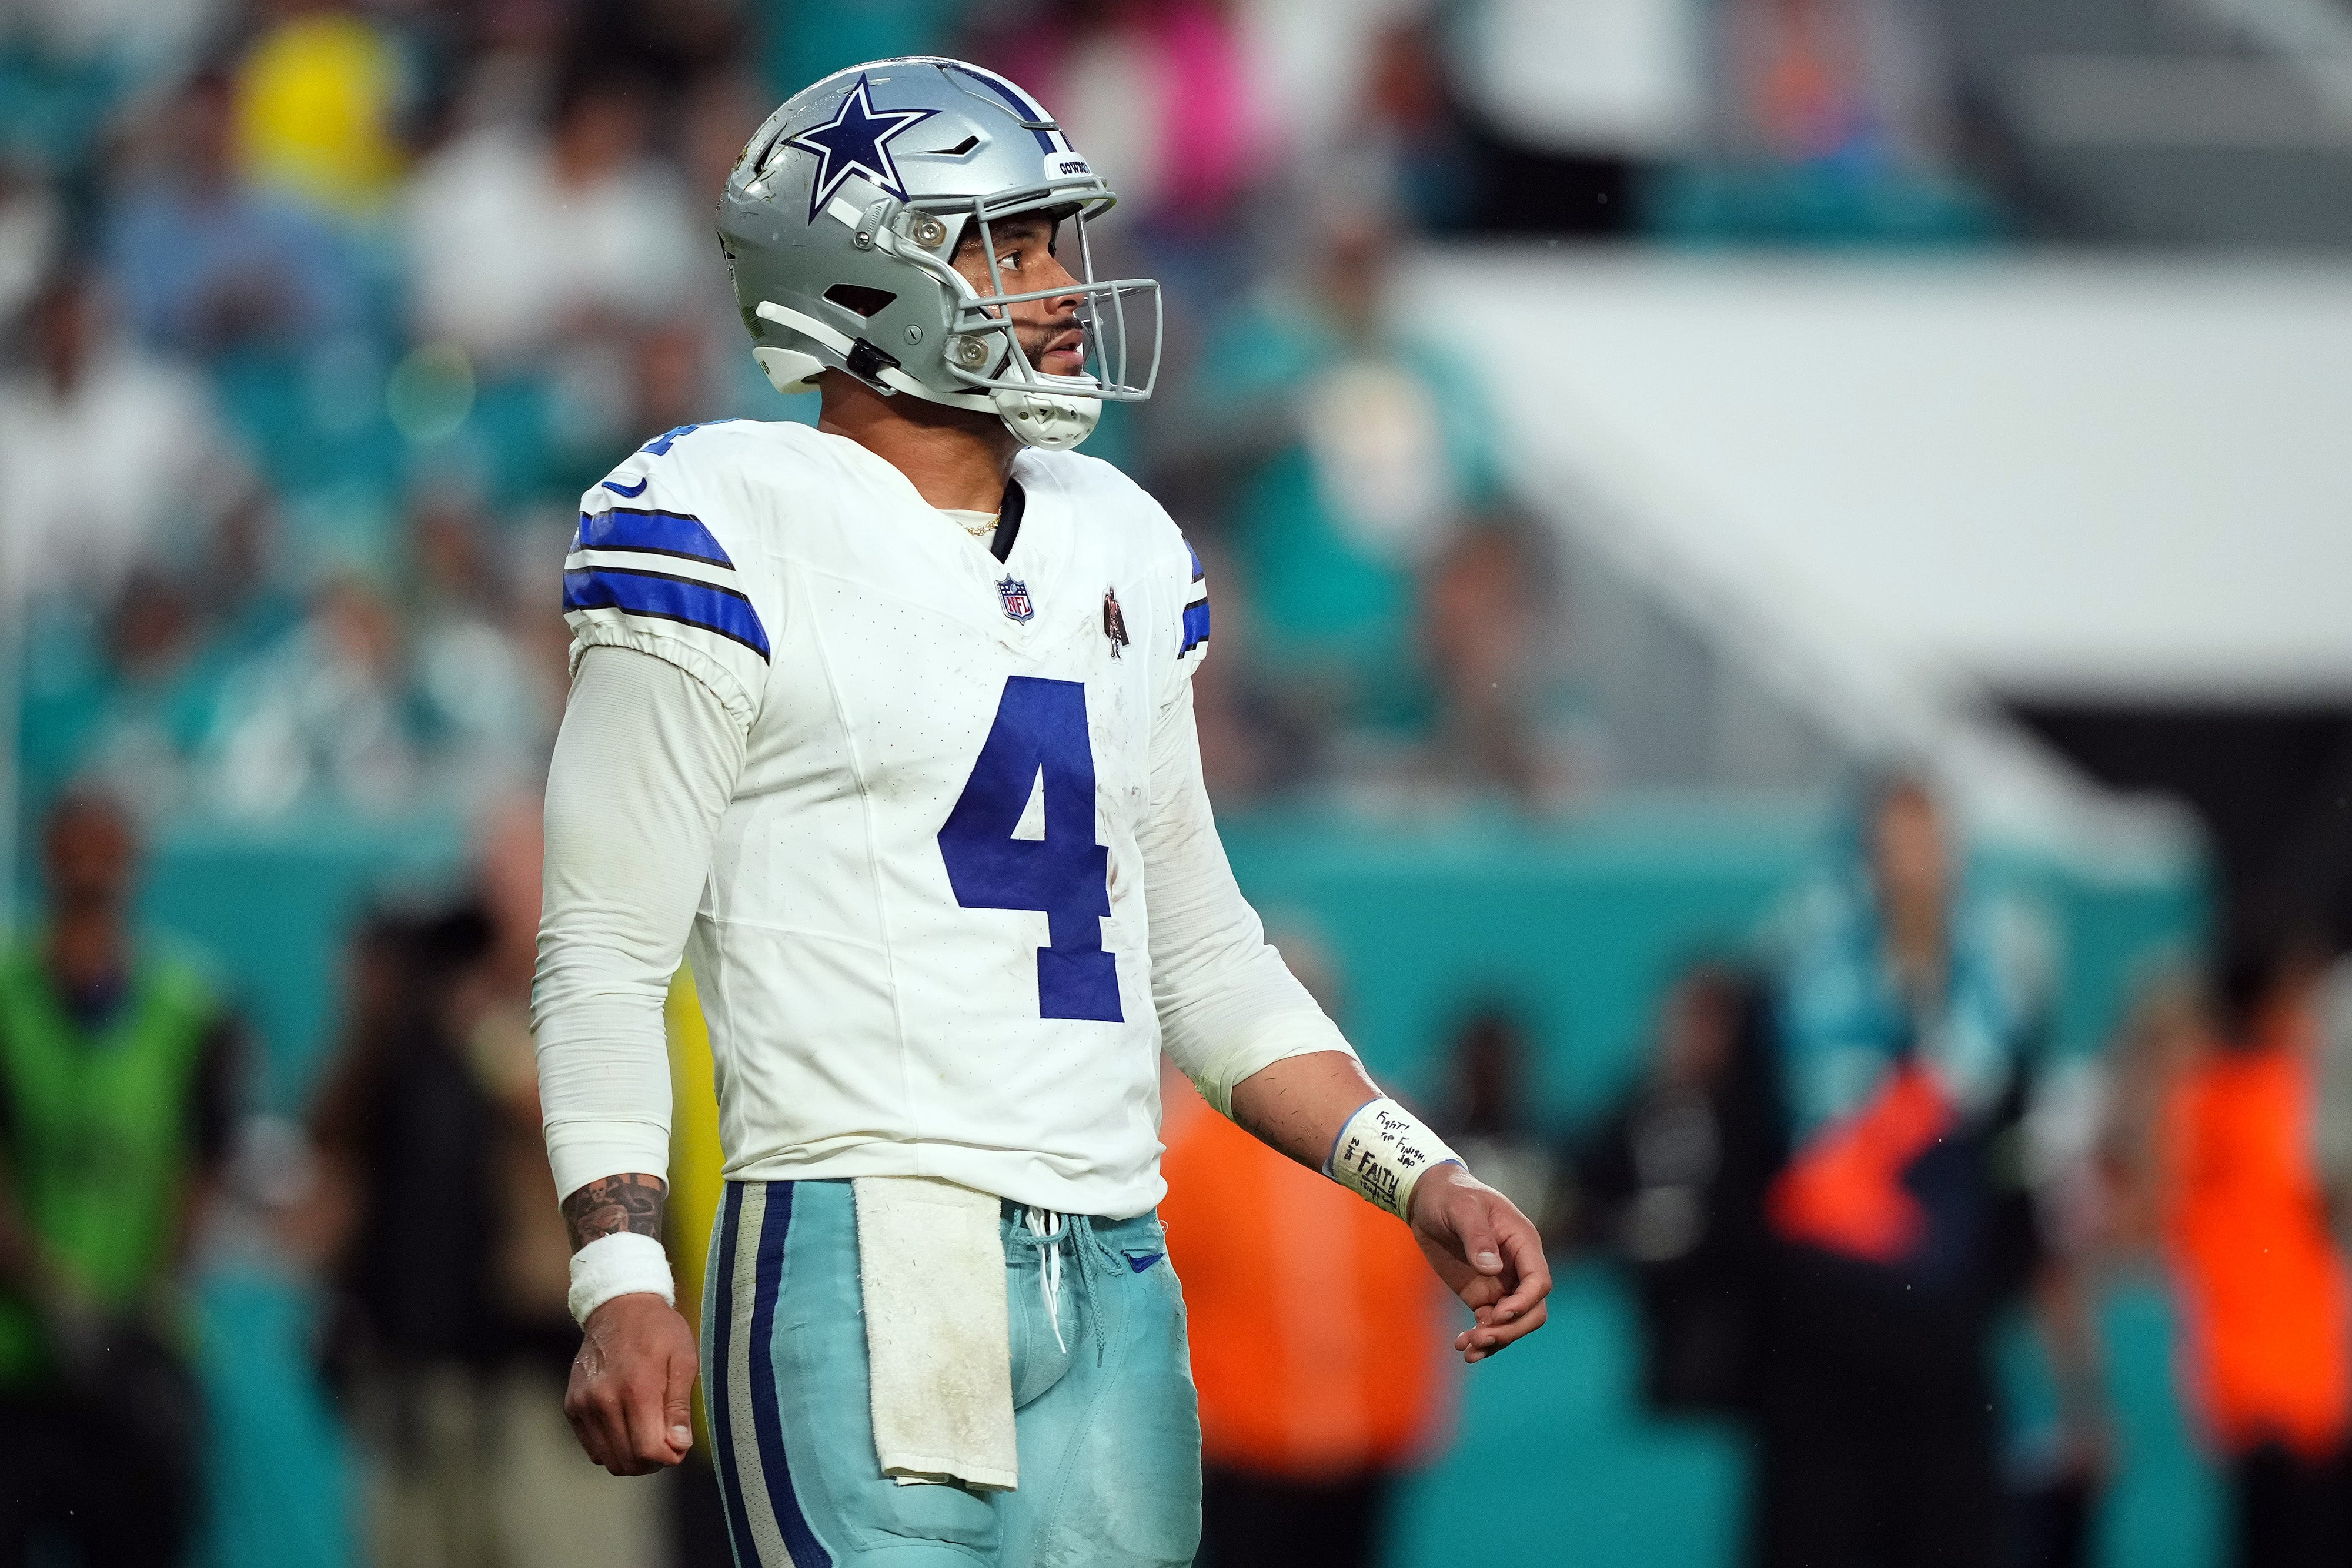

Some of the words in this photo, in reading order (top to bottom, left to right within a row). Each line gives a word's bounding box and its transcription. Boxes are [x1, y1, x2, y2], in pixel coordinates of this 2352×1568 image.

[1005, 596, 1031, 615] NFL
[937, 676, 1125, 1023] 4
[1357, 1150, 1400, 1196] FAITH
